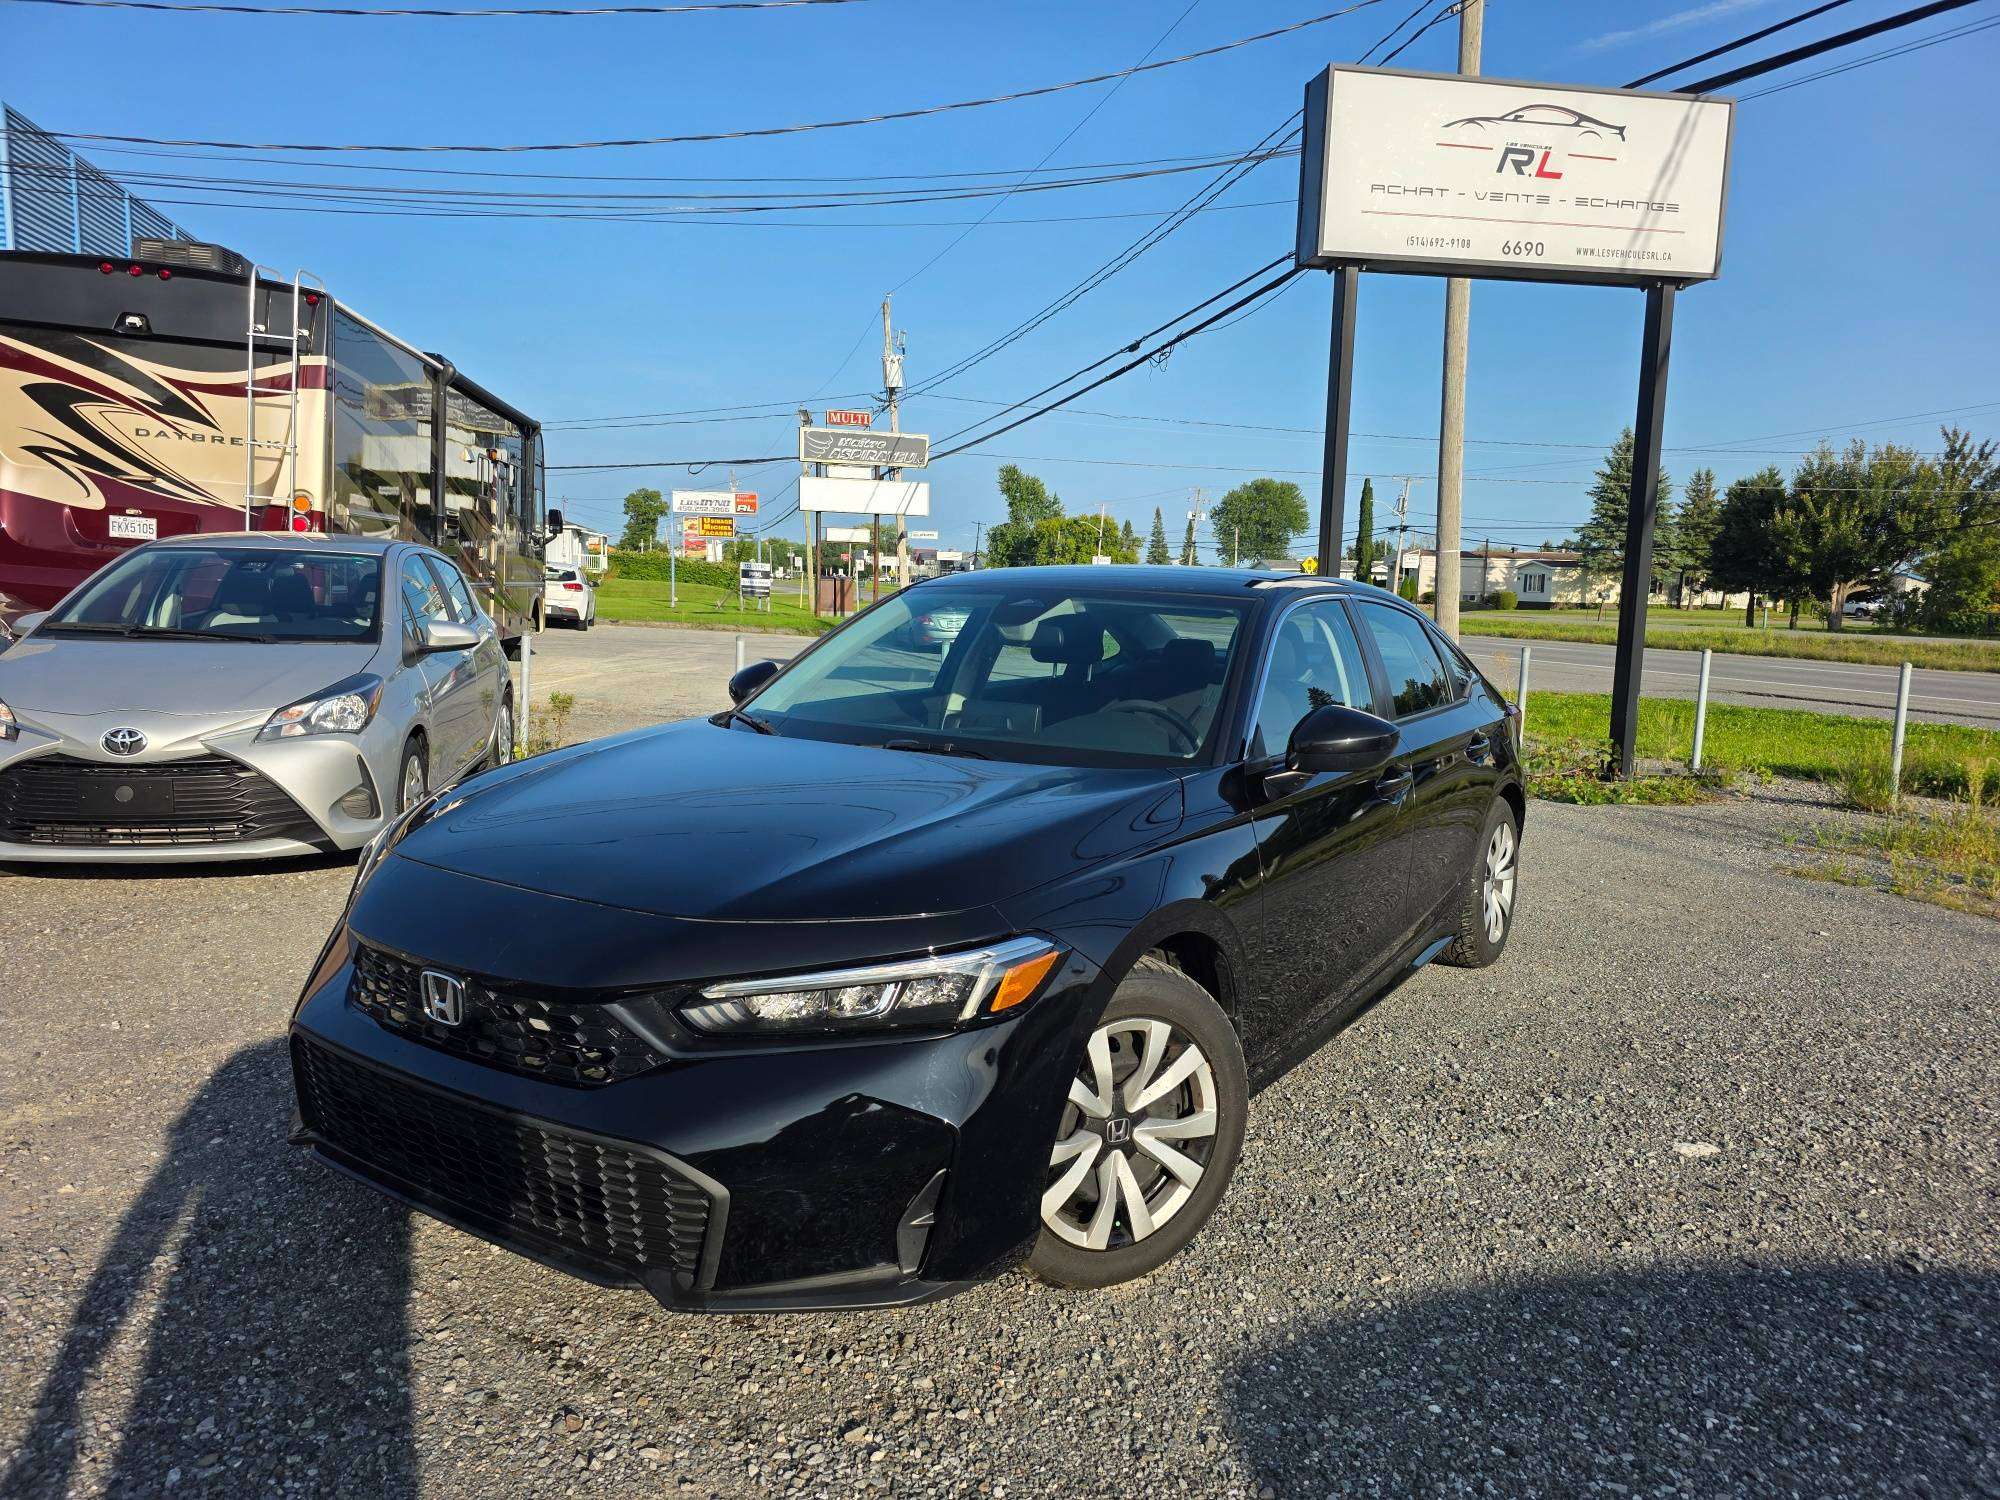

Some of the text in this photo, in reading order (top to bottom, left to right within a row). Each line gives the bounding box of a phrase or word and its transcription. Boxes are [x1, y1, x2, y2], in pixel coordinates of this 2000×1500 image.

[1371, 184, 1450, 198] ACHAT
[1474, 190, 1550, 205] VENTE
[1575, 197, 1680, 213] ECHANGE
[1406, 235, 1471, 249] (514)692-9108
[1502, 240, 1544, 257] 6690
[1576, 247, 1672, 262] WWW.LESVEHICULESRL.CA
[830, 412, 869, 425] MULTI
